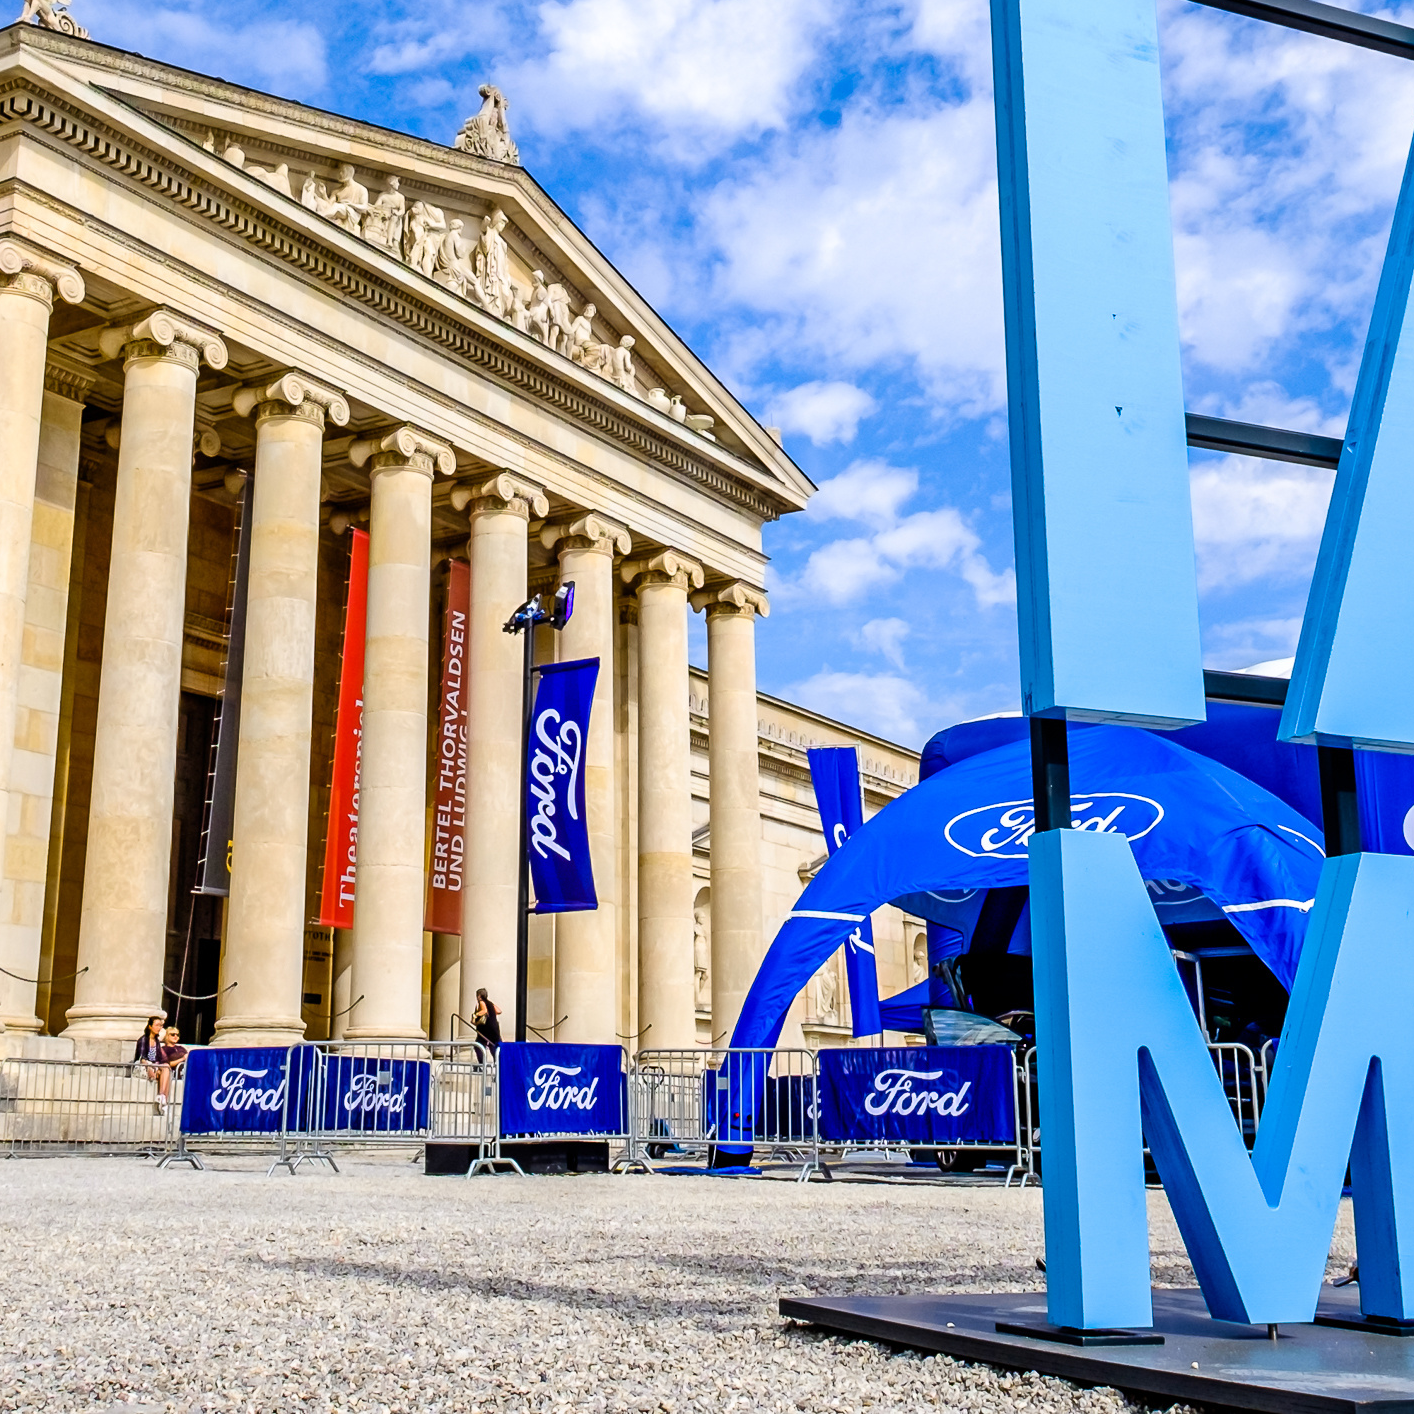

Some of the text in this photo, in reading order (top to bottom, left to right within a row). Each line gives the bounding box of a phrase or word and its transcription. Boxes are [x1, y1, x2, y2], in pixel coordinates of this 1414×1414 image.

[433, 611, 466, 889] BERTEL THORVALDSEN
[531, 709, 581, 861] Ford
[448, 835, 464, 892] UND
[211, 1067, 285, 1112] Ford
[344, 1072, 407, 1114] Ford
[527, 1063, 597, 1111] Ford
[865, 1069, 969, 1117] Ford
